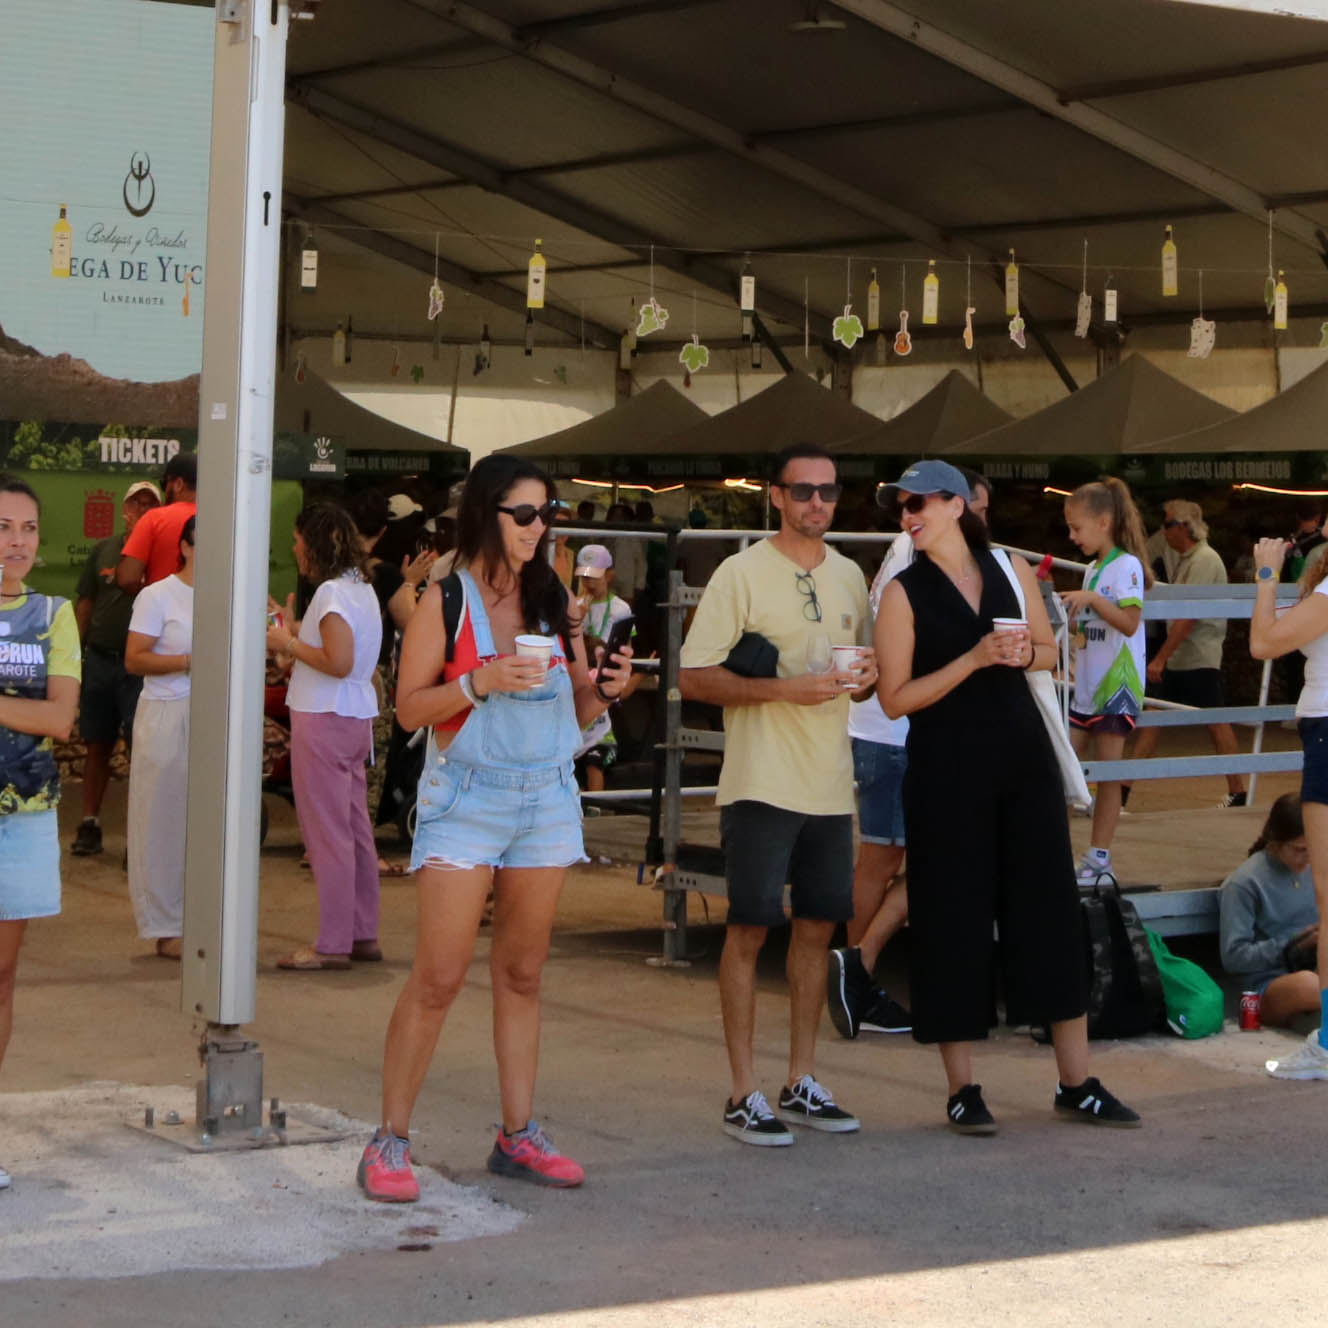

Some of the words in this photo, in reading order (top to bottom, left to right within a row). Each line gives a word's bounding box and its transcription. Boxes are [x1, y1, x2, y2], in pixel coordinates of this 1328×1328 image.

[68, 258, 110, 279] EGA
[119, 260, 148, 281] DE
[157, 255, 203, 284] YUC
[98, 437, 180, 464] TICKETS
[1164, 461, 1212, 479] BODEGAS
[1085, 627, 1106, 642] UN
